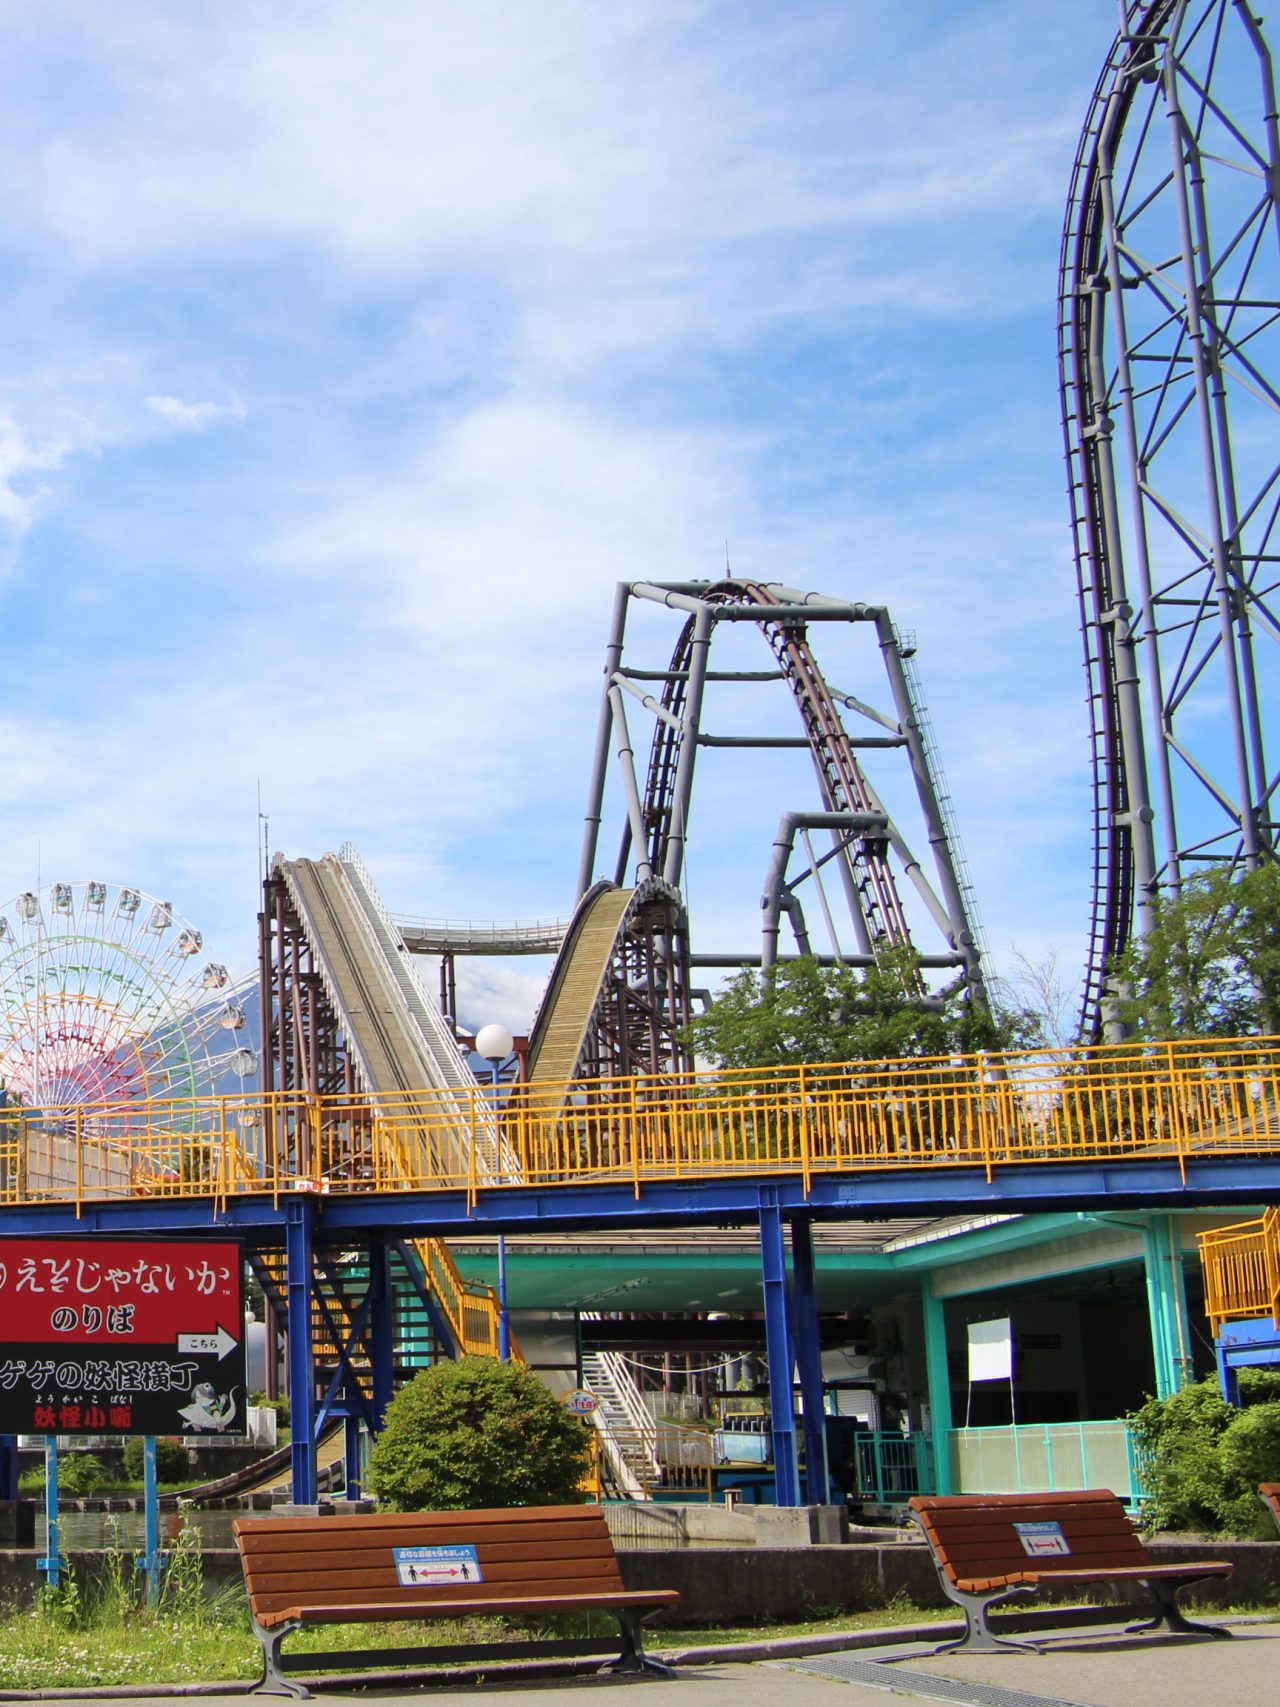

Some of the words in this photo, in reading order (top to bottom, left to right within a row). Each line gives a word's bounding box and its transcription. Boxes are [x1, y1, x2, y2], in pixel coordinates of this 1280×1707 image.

[50, 1304, 135, 1334] のりば
[190, 1339, 218, 1349] こちら
